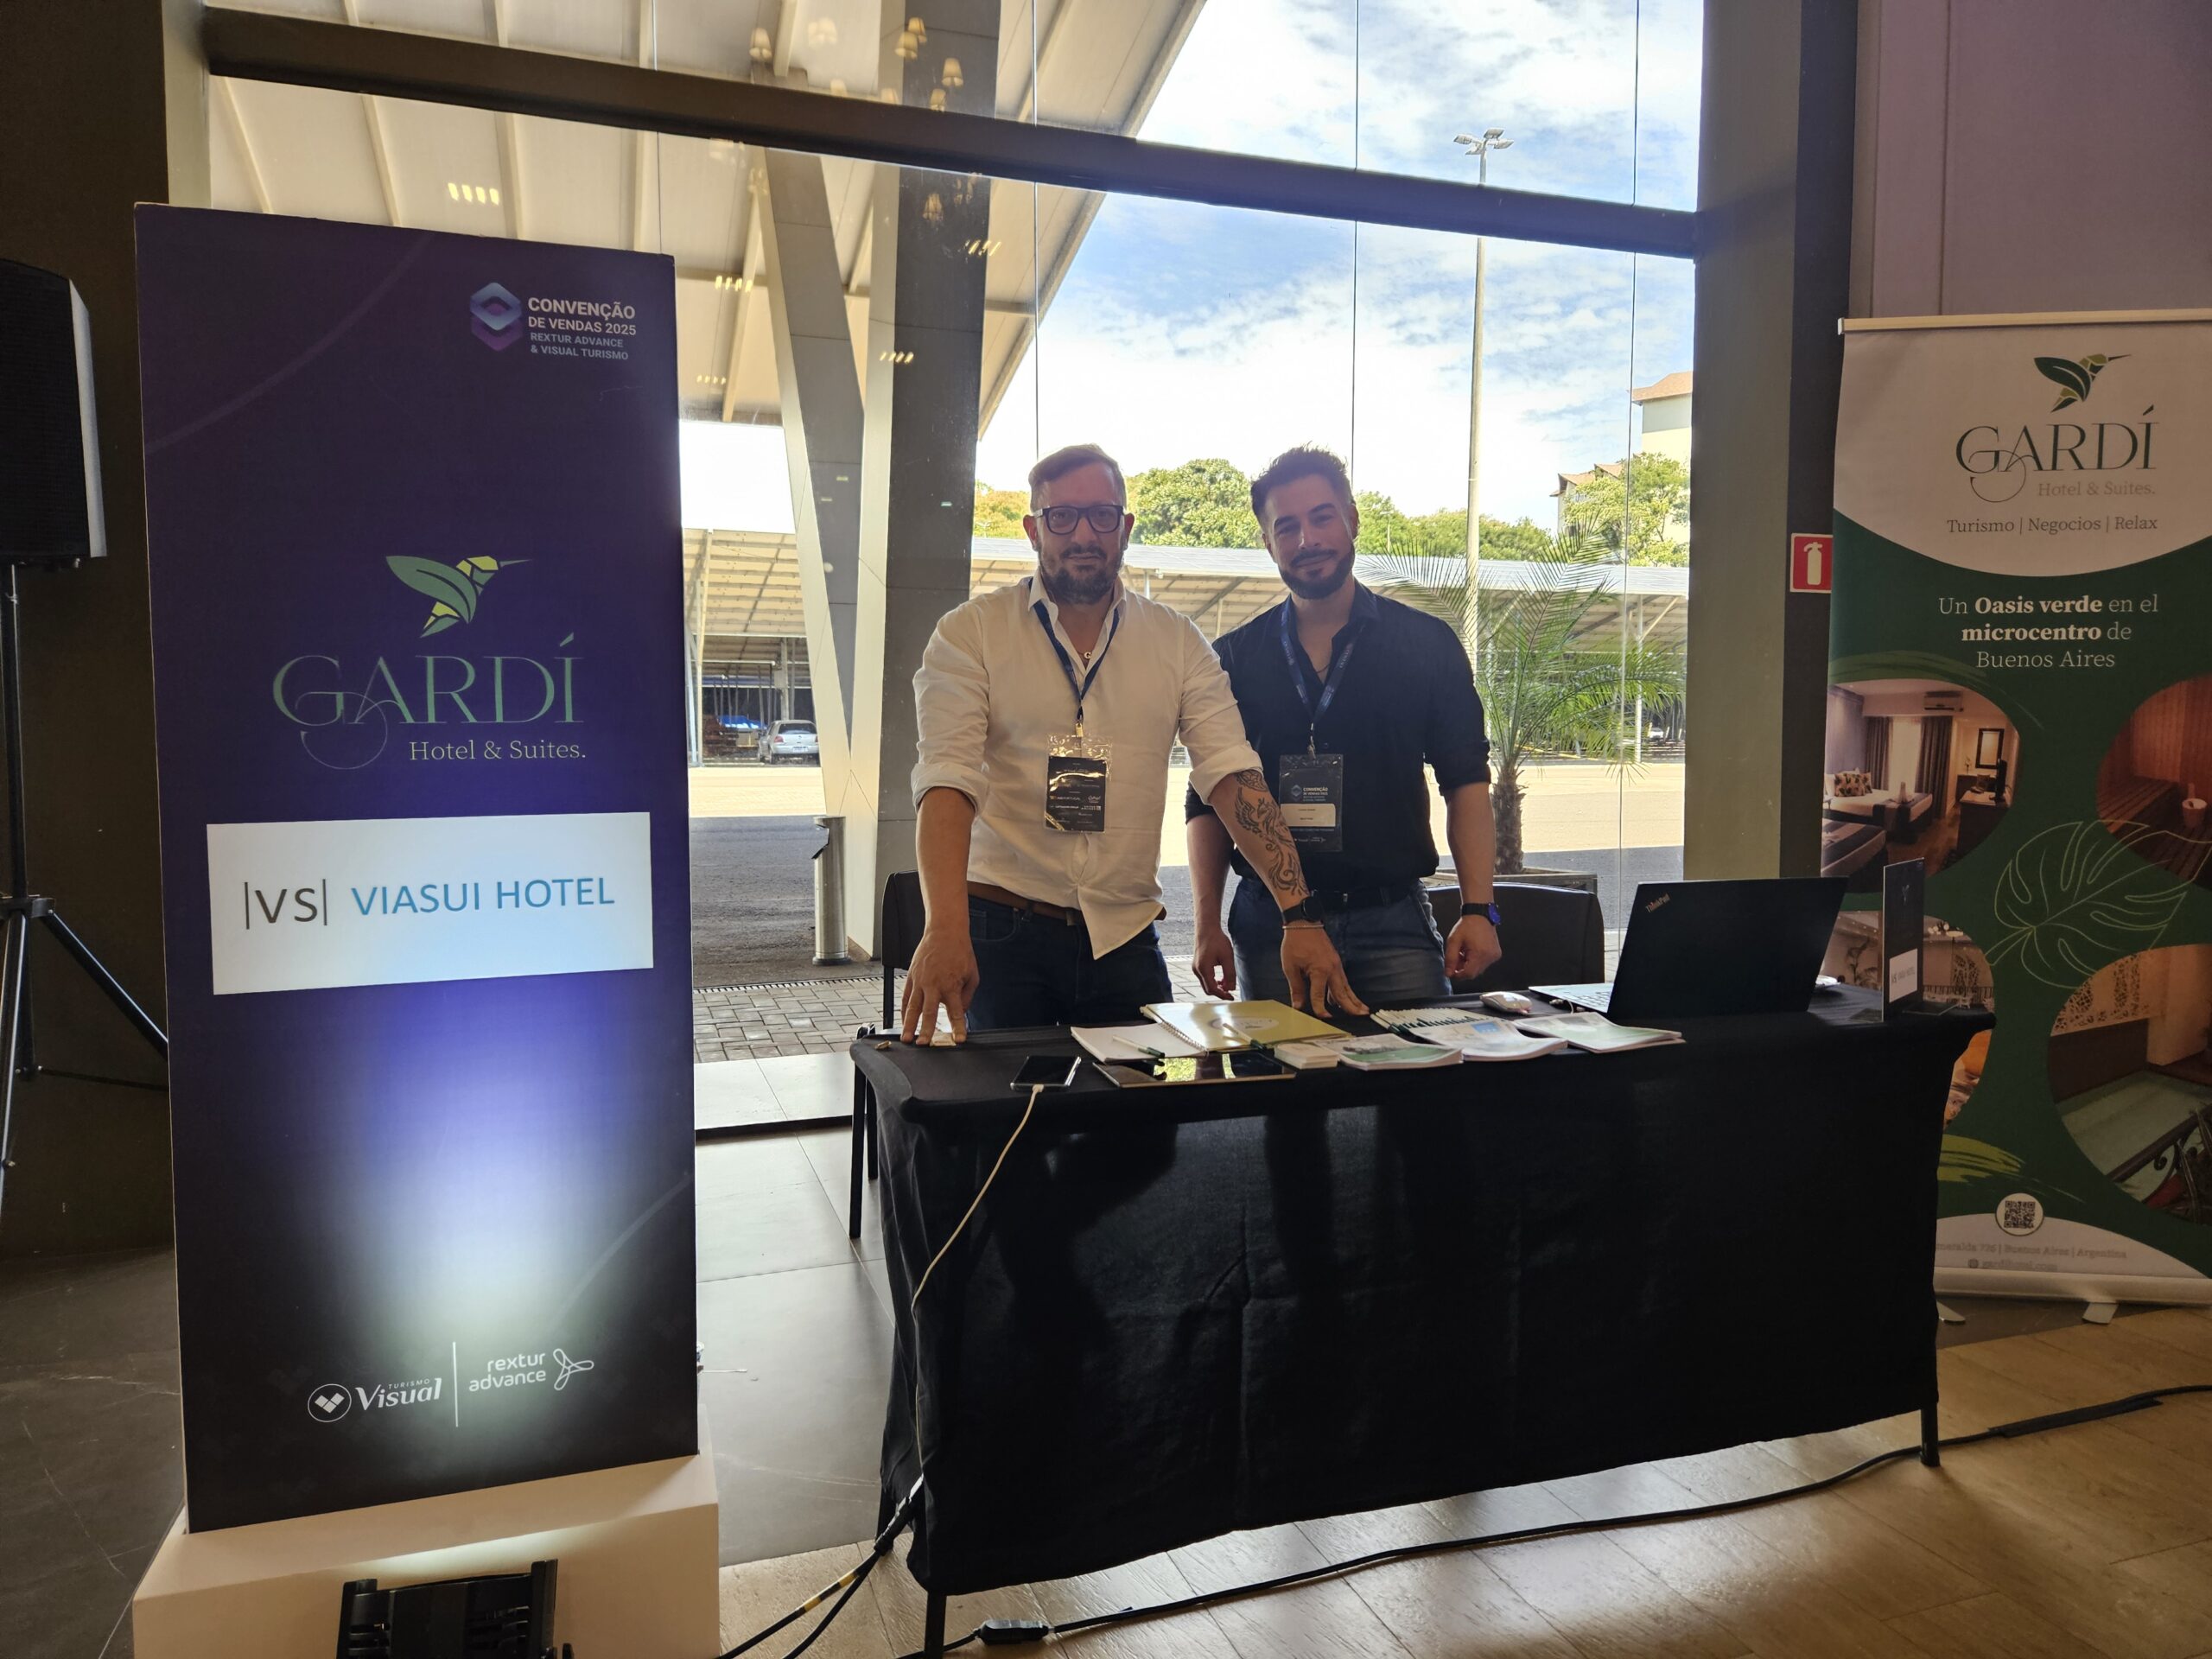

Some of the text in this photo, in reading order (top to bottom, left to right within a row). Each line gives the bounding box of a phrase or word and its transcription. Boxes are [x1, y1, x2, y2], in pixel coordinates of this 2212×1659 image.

[528, 297, 636, 321] CONVENÇÃO
[528, 316, 637, 336] DE VENDAS 2025
[531, 332, 624, 348] REXTUR ADVANCE
[531, 345, 629, 360] & VISUAL TURISMO
[1955, 404, 2159, 503] GARDÍ
[2037, 480, 2157, 498] Hotel & Suites.
[1947, 518, 2015, 534] Turismo
[2028, 516, 2101, 536] Negocios
[2114, 515, 2158, 531] Relax
[1939, 594, 2158, 615] Un Oasis verde en el
[1961, 621, 2133, 642] microcentro de
[1976, 651, 2116, 669] Buenos Aires
[272, 632, 585, 770] GARDÍ
[409, 738, 587, 760] Hotel & Suites.
[351, 882, 480, 916] VIASUI
[497, 877, 615, 909] HOTEL
[2076, 1248, 2127, 1259] Argentina
[487, 1351, 546, 1372] rextur
[388, 1378, 430, 1389] TURISMO
[468, 1369, 546, 1392] advance
[354, 1377, 442, 1411] Visual
